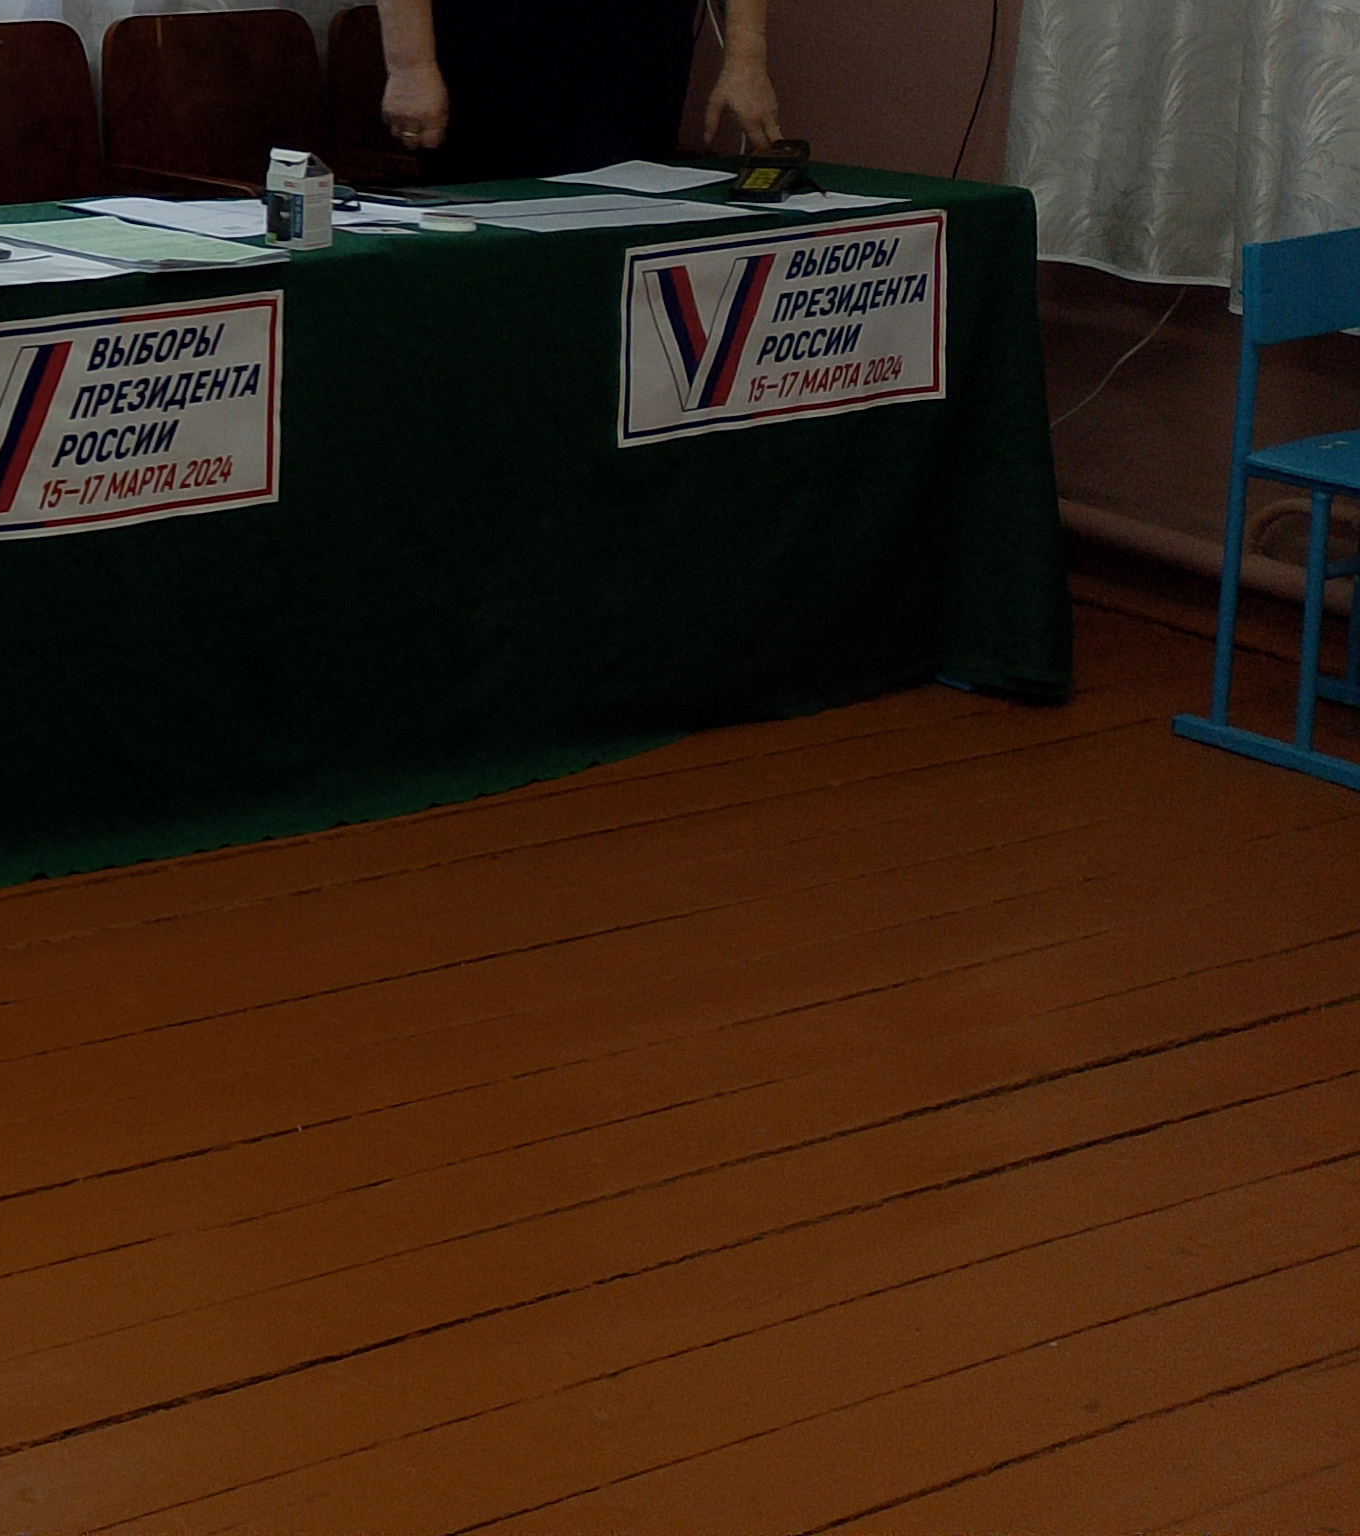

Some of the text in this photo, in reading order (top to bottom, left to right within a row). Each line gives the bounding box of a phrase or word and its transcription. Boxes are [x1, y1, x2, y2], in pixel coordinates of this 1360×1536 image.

[784, 237, 901, 280] ВЫБОРЫ
[771, 273, 929, 323] ПРЕЗИДЕНТА
[86, 323, 226, 372] ВЫБОРЫ
[756, 323, 863, 366] РОССИИ
[69, 363, 262, 421] ПРЕЗИДЕНТА
[798, 363, 861, 397] МАРТА
[863, 355, 904, 385] 2024
[51, 419, 180, 469] РОССИИ
[104, 463, 177, 505] МАРТА
[178, 455, 233, 491] 2024
